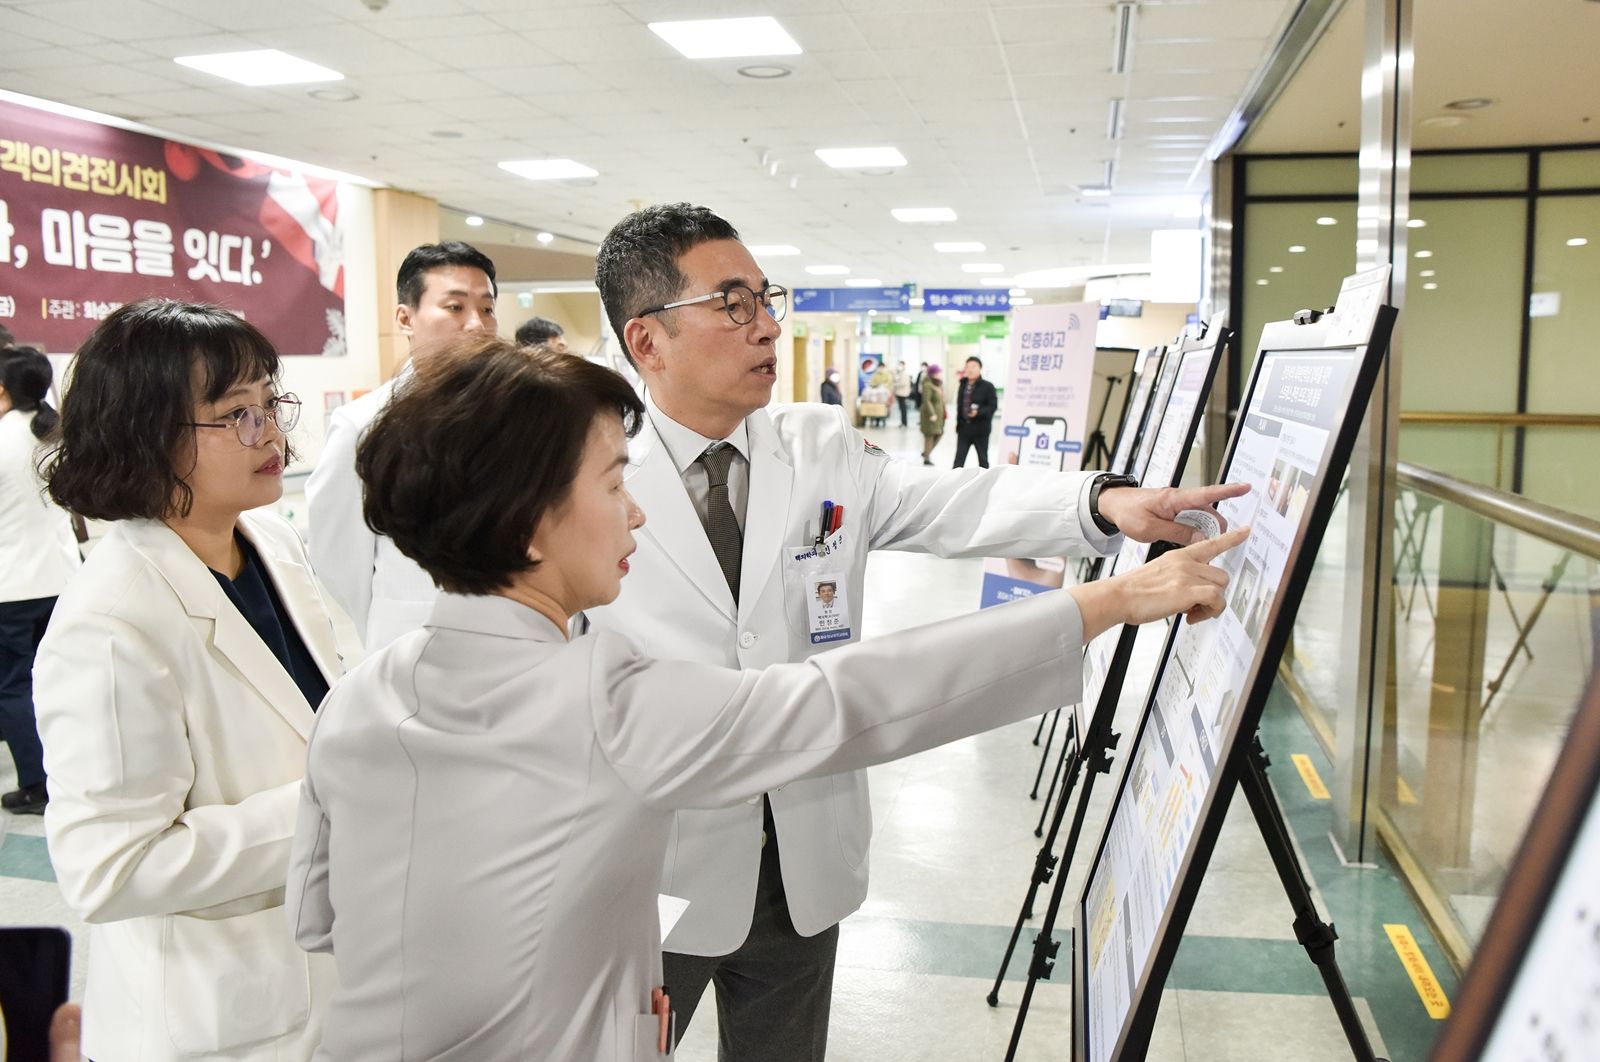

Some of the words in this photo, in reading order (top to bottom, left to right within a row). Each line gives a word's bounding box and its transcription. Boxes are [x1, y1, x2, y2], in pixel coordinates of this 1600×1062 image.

[41, 207, 174, 277] 마음을
[1021, 331, 1066, 349] 인증하고
[1018, 354, 1064, 372] 선물받자
